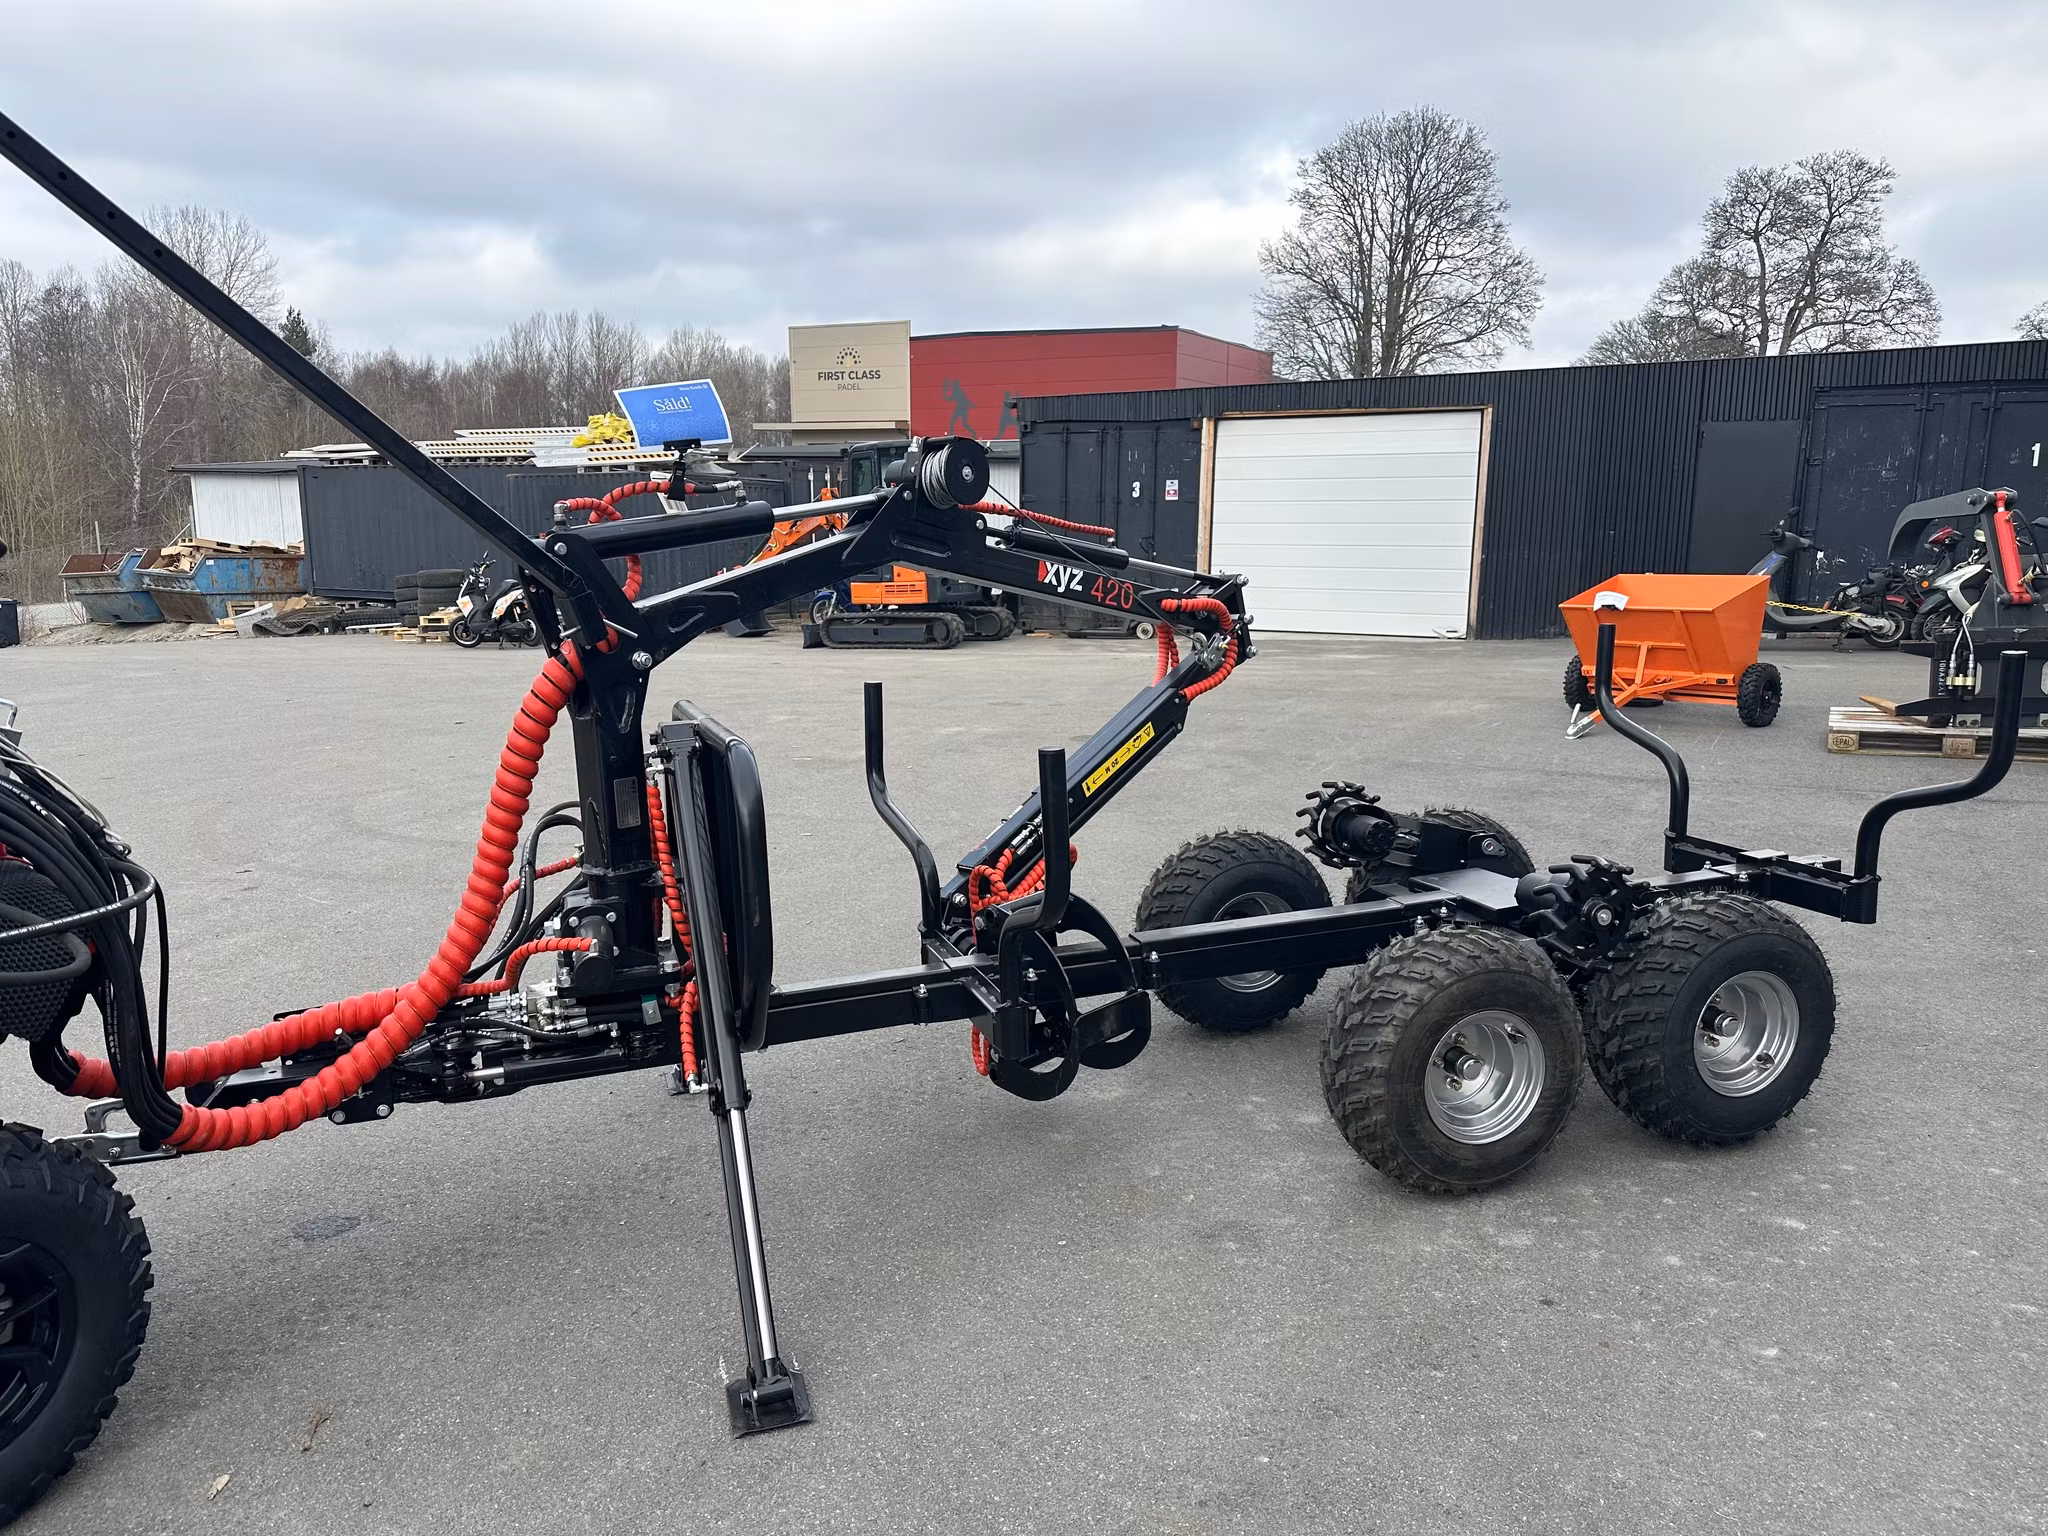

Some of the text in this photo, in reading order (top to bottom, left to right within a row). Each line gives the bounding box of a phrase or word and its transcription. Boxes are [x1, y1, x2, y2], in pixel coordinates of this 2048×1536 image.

[817, 370, 881, 381] FIRST CLASS
[837, 383, 862, 391] PADEL
[653, 396, 693, 412] Såld!
[2031, 442, 2041, 467] 1
[1132, 481, 1140, 498] 3
[1090, 575, 1134, 609] 420
[1104, 758, 1119, 774] 20 M
